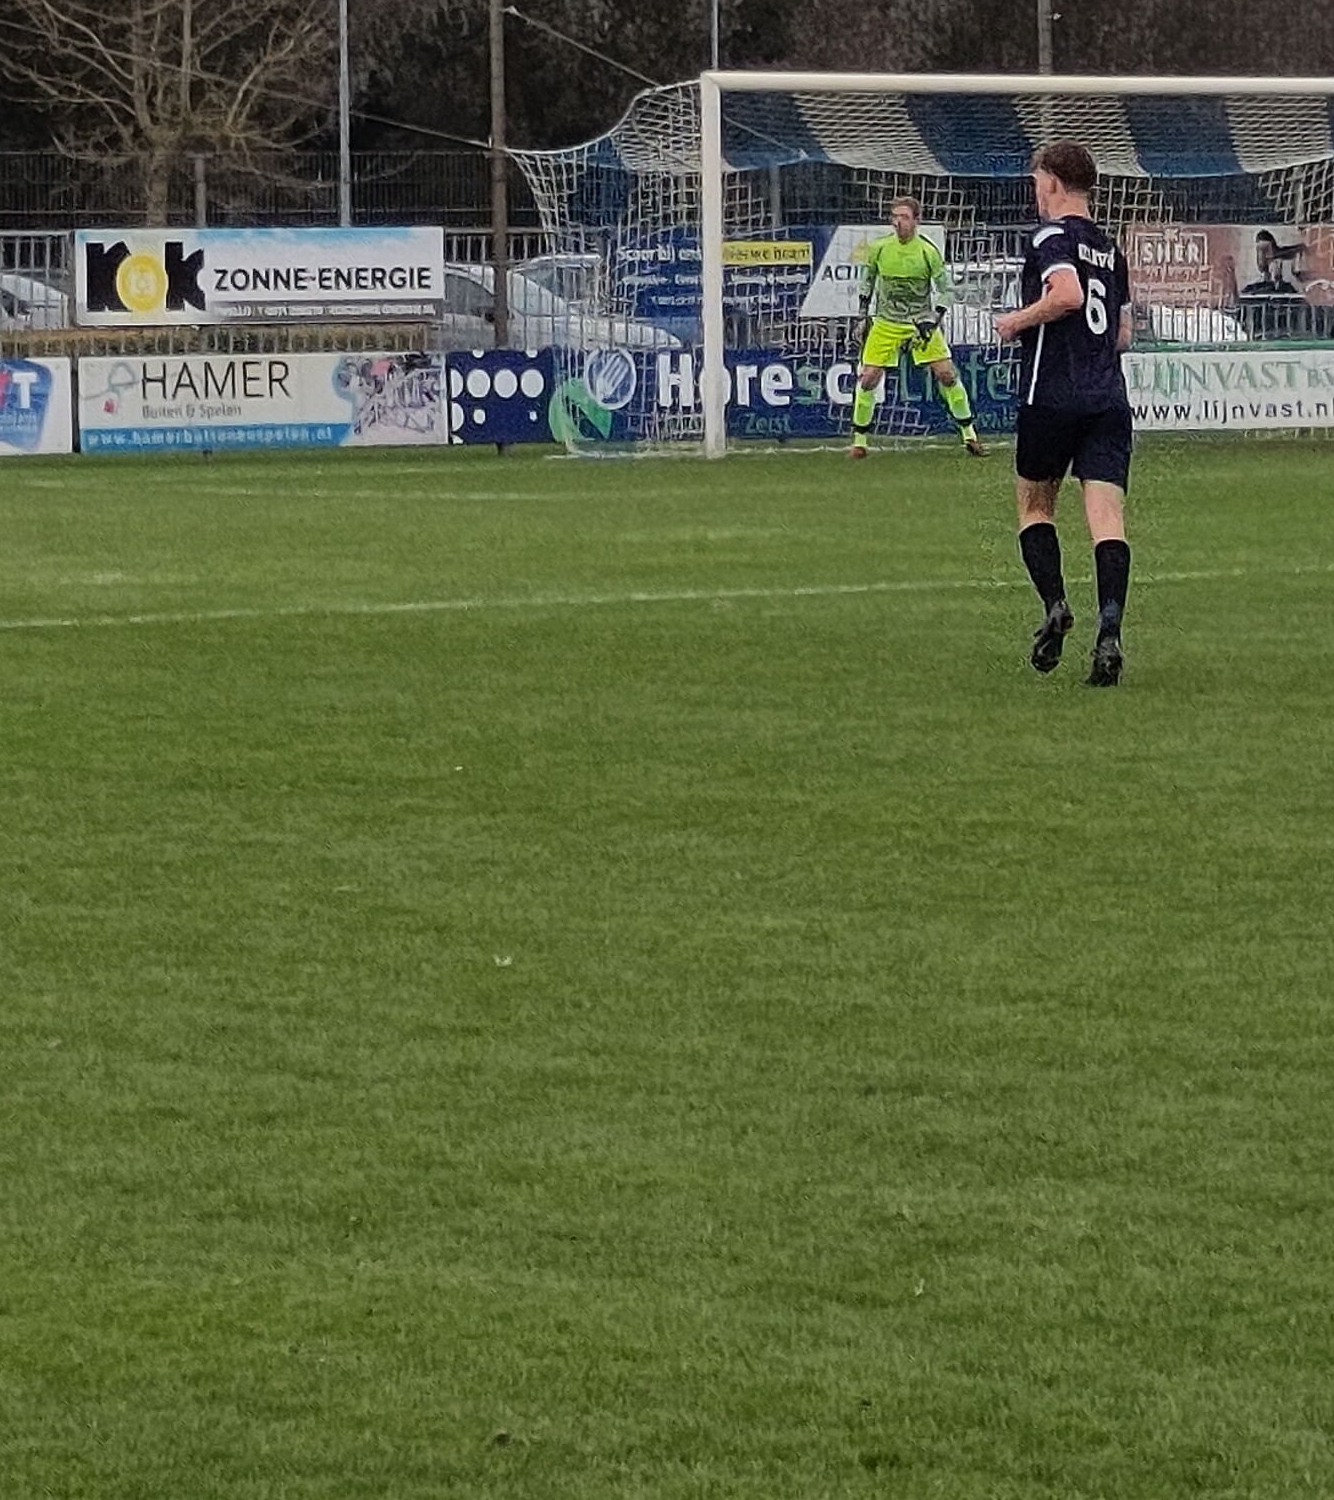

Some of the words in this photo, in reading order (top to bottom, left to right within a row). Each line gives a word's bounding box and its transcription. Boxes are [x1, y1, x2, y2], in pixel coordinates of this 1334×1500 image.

[214, 267, 432, 291] ZONNE-ENERGIE
[1085, 278, 1108, 335] 6
[141, 360, 293, 401] HAMER
